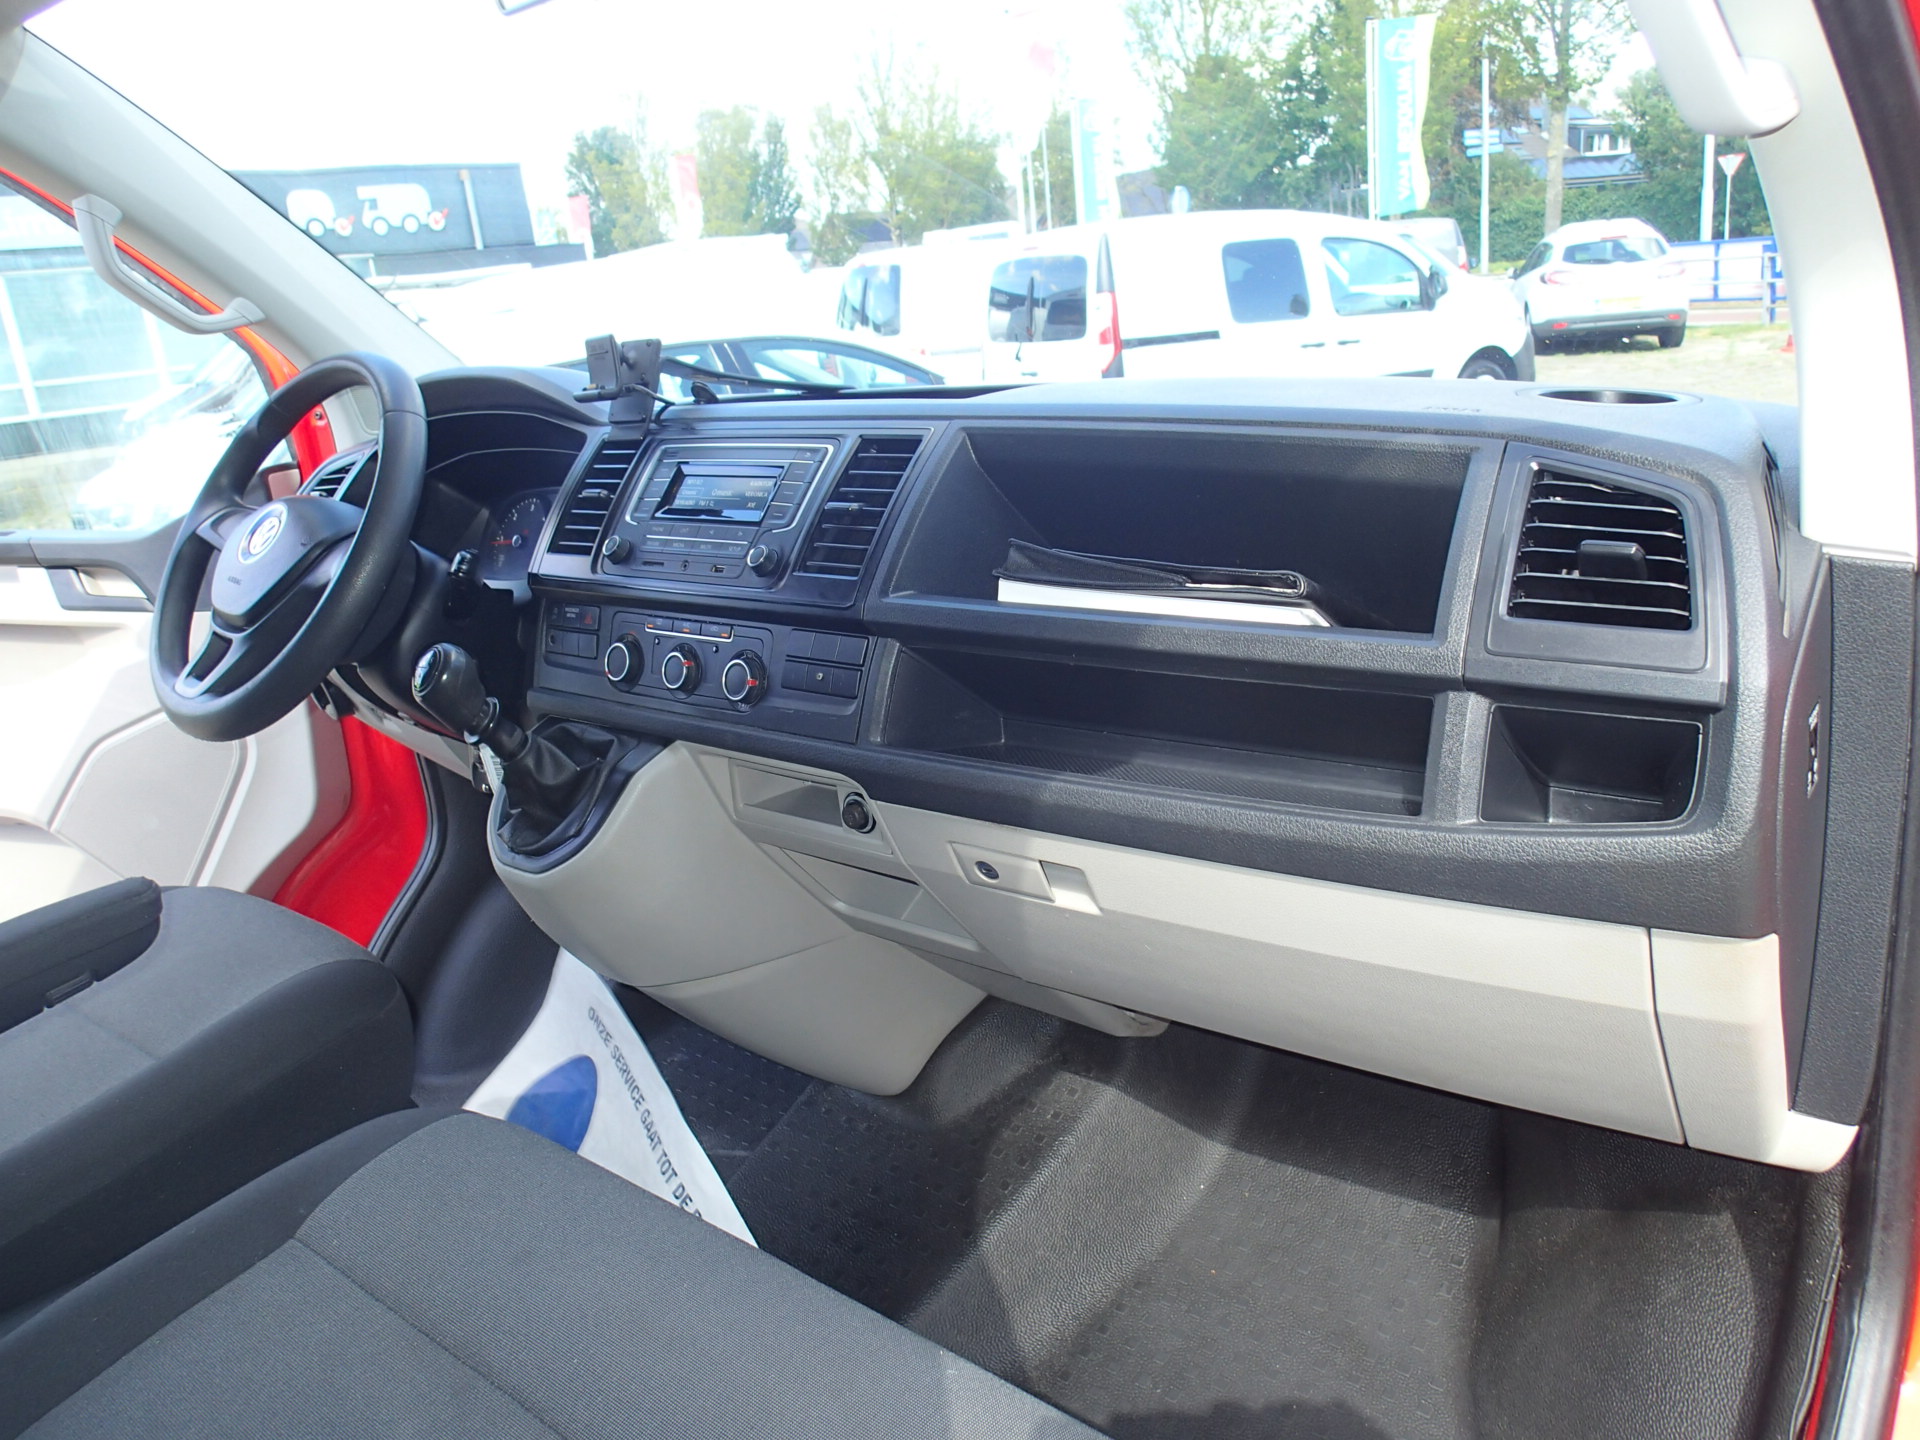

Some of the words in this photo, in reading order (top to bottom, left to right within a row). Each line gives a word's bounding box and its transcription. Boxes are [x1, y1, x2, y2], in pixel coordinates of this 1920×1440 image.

[588, 1006, 613, 1048] ONZE
[610, 1044, 646, 1111] SERVICE
[640, 1108, 662, 1152] GAAT
[657, 1148, 679, 1184] TOT
[672, 1182, 693, 1208] DE
